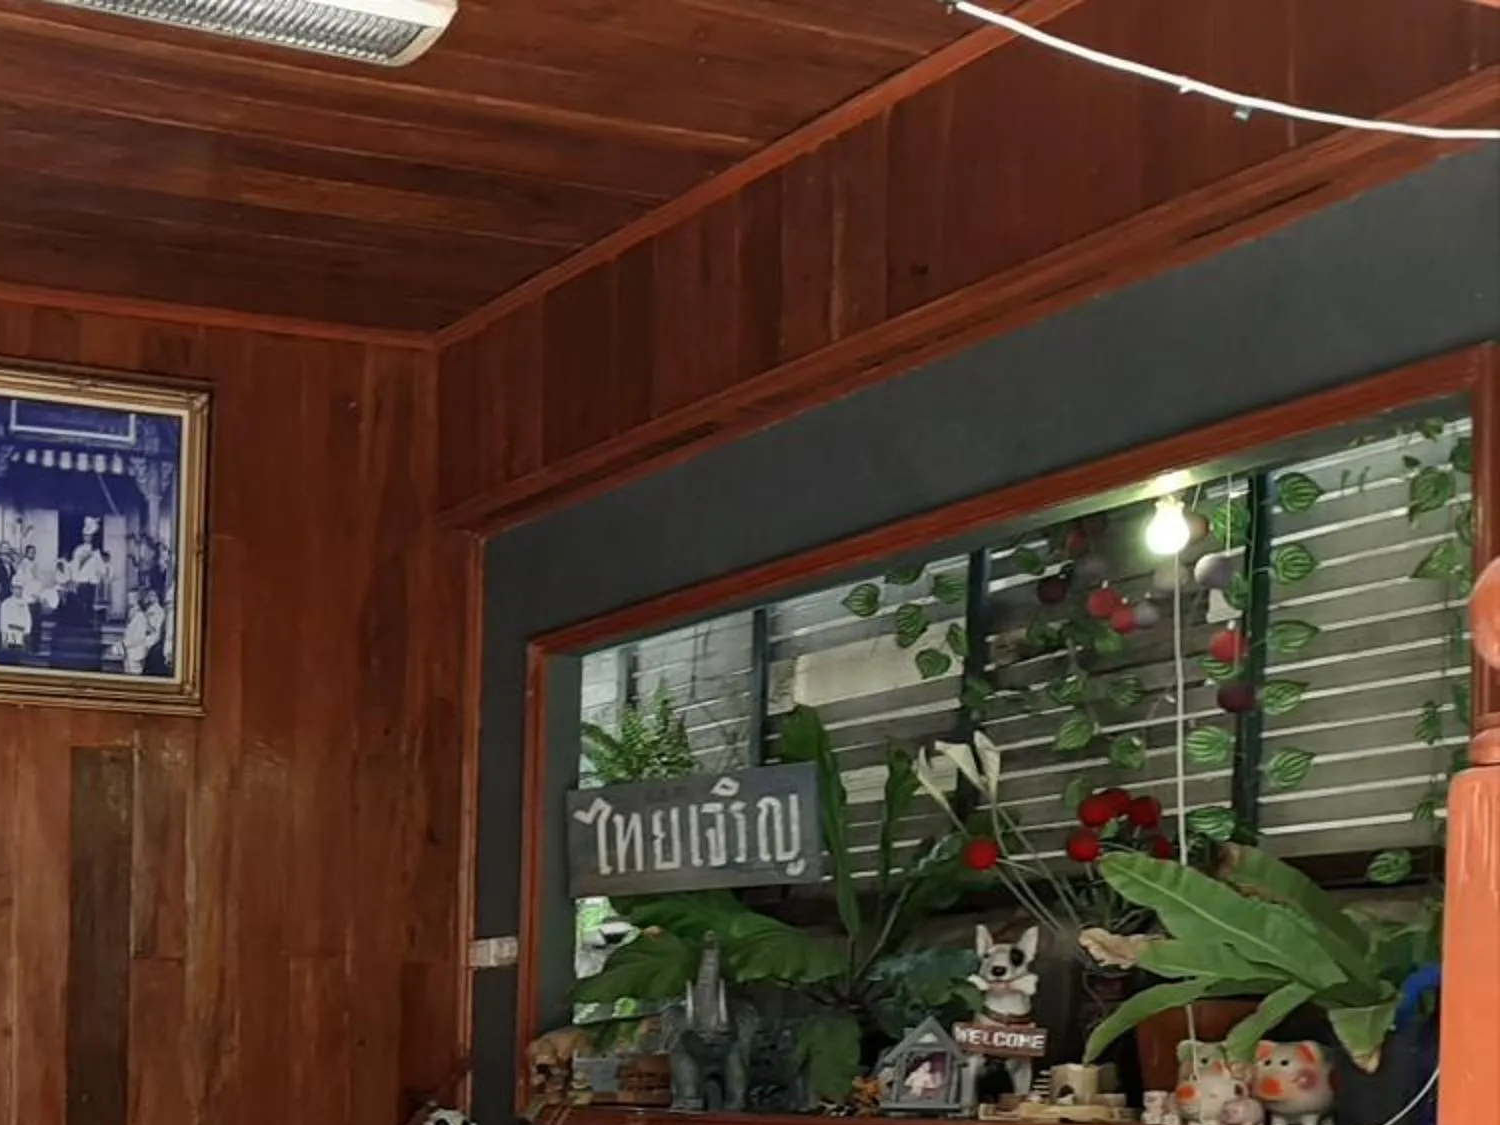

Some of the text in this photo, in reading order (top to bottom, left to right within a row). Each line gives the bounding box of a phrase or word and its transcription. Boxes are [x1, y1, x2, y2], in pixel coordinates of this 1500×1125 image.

[573, 776, 806, 876] ไทยเจริญ
[954, 1025, 1045, 1049] WELCOME
